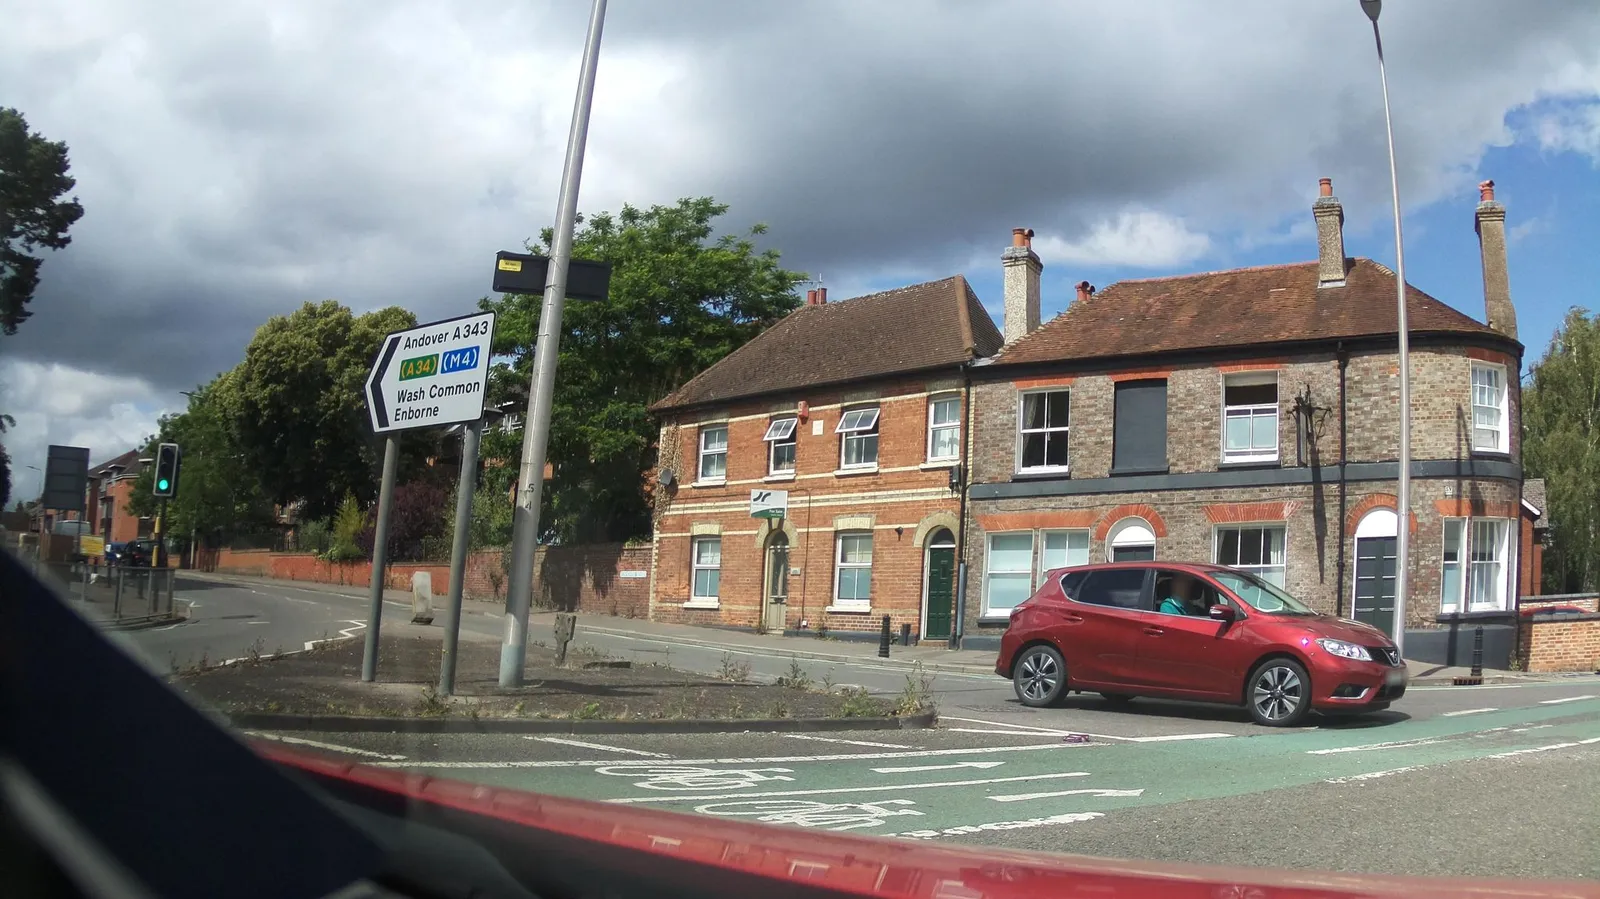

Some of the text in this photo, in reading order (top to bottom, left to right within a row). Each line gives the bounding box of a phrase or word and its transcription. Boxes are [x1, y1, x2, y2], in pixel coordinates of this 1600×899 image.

[404, 321, 488, 350] Andover A343
[402, 349, 476, 378] (A34) (M4)
[398, 382, 480, 403] Wash Common
[395, 406, 439, 422] Enborne
